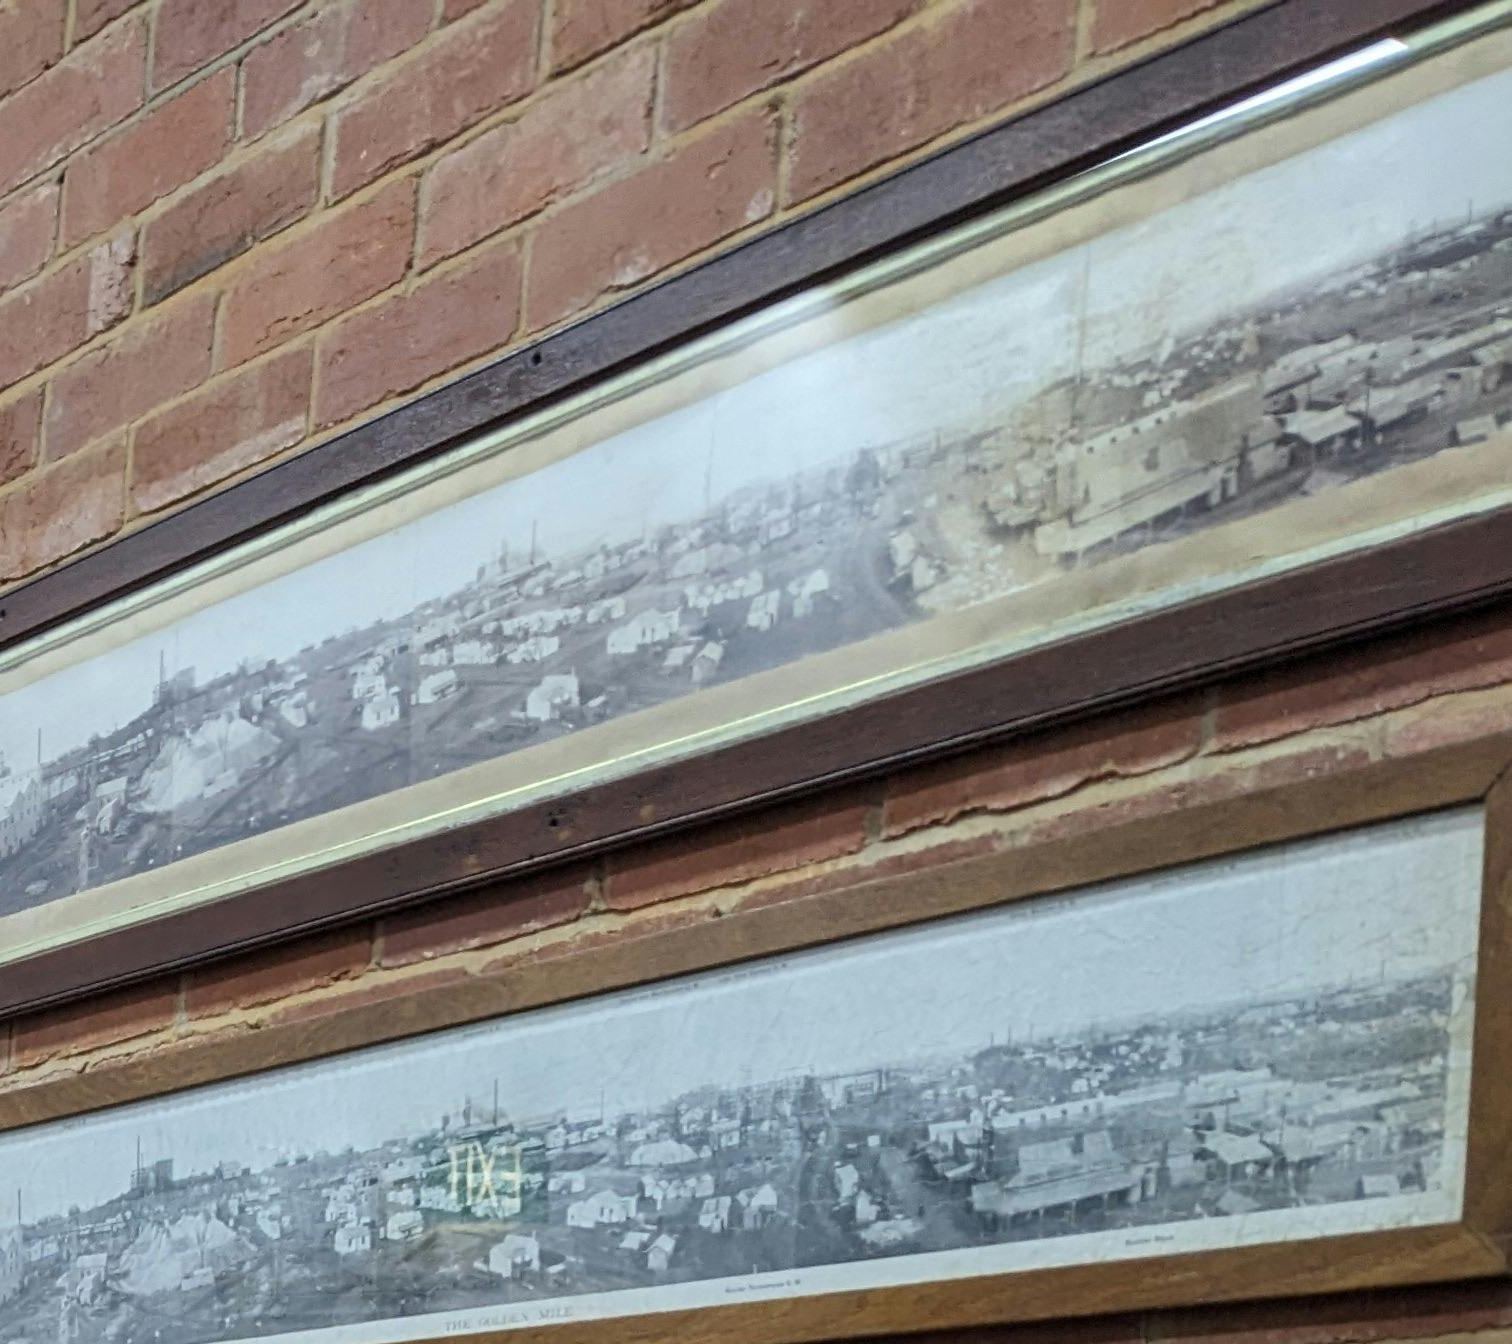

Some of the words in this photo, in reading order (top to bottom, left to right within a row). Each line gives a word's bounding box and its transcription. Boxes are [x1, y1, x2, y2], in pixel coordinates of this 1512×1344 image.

[444, 1320, 471, 1332] THE
[477, 1312, 529, 1328] GOLDEN
[538, 1306, 574, 1321] MILE
